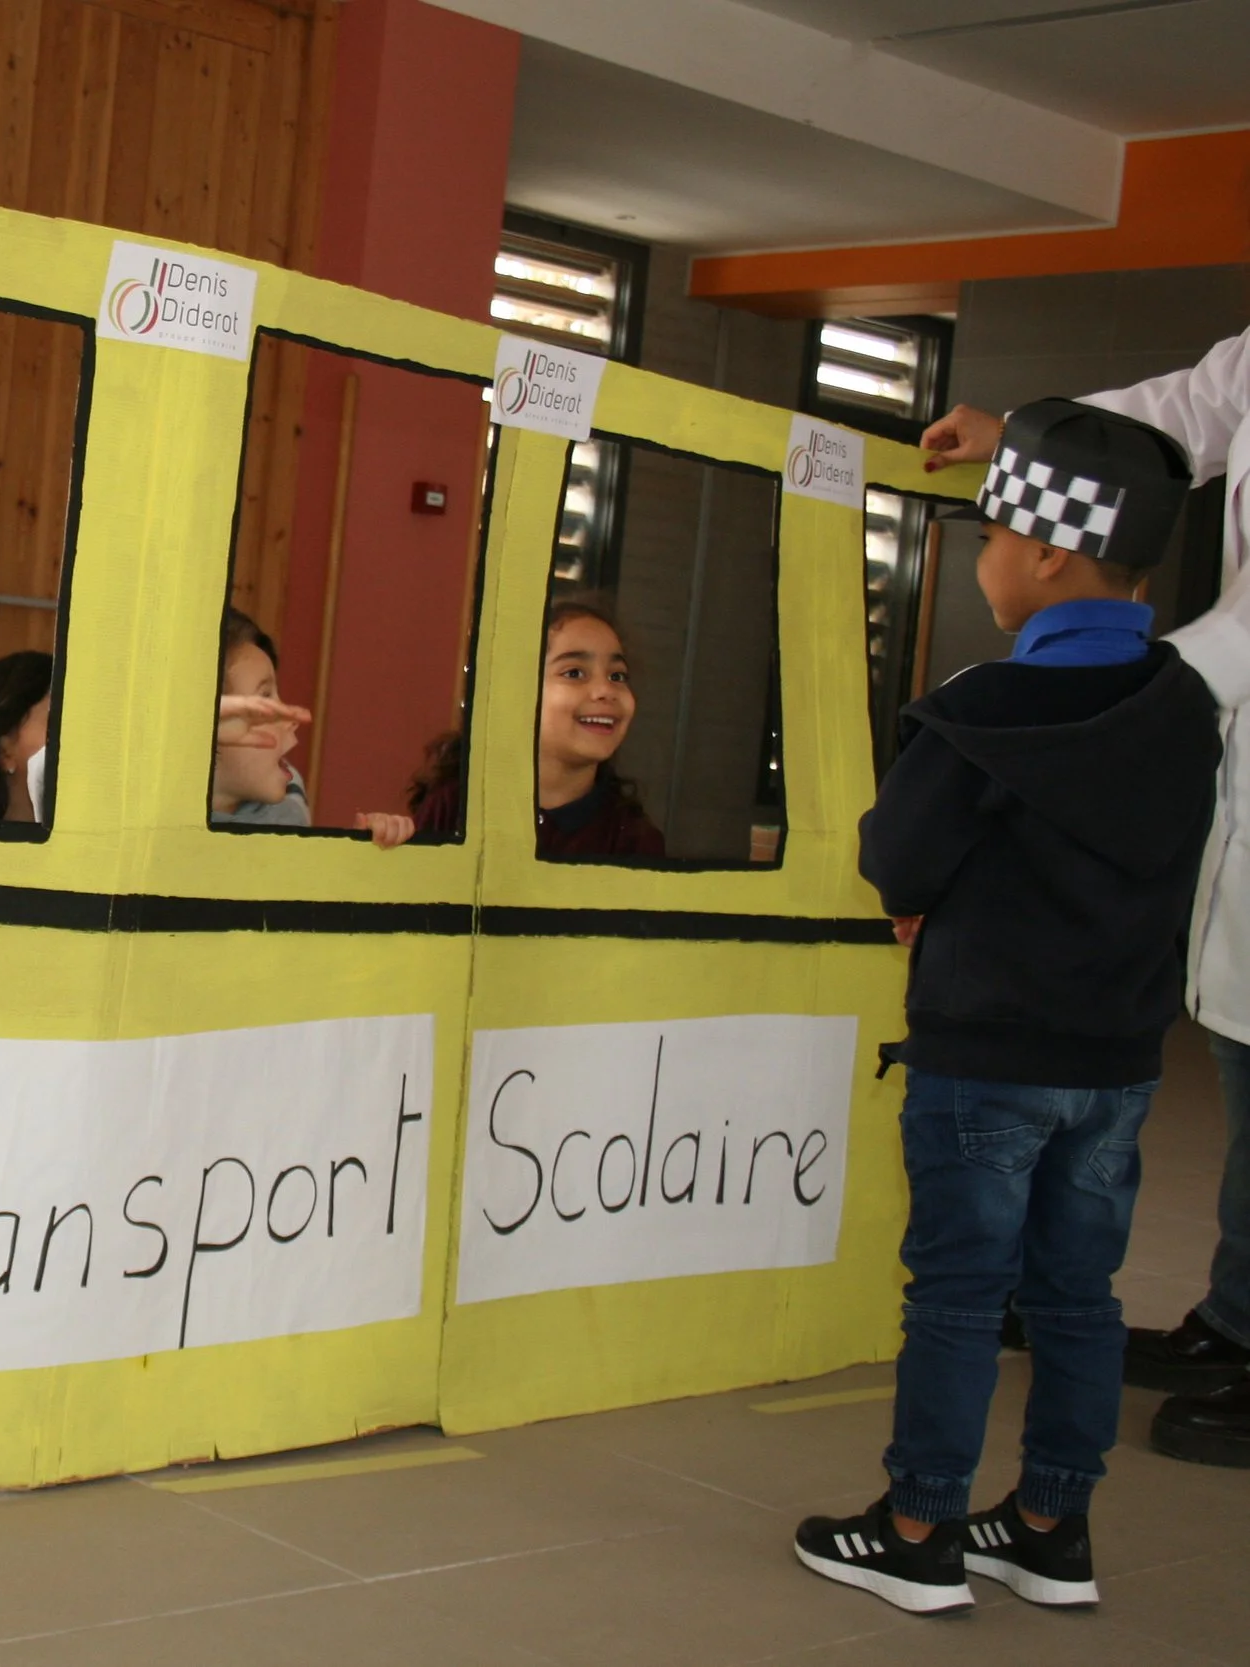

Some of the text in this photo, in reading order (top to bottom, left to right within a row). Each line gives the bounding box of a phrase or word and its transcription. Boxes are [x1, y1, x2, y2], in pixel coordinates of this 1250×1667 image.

[168, 263, 228, 298] Denis
[161, 297, 238, 336] Diderot
[535, 354, 577, 383] Denis
[528, 383, 582, 415] Diderot
[816, 433, 847, 459] Denis
[813, 459, 854, 487] Diderot
[482, 1034, 828, 1236] Scolaire
